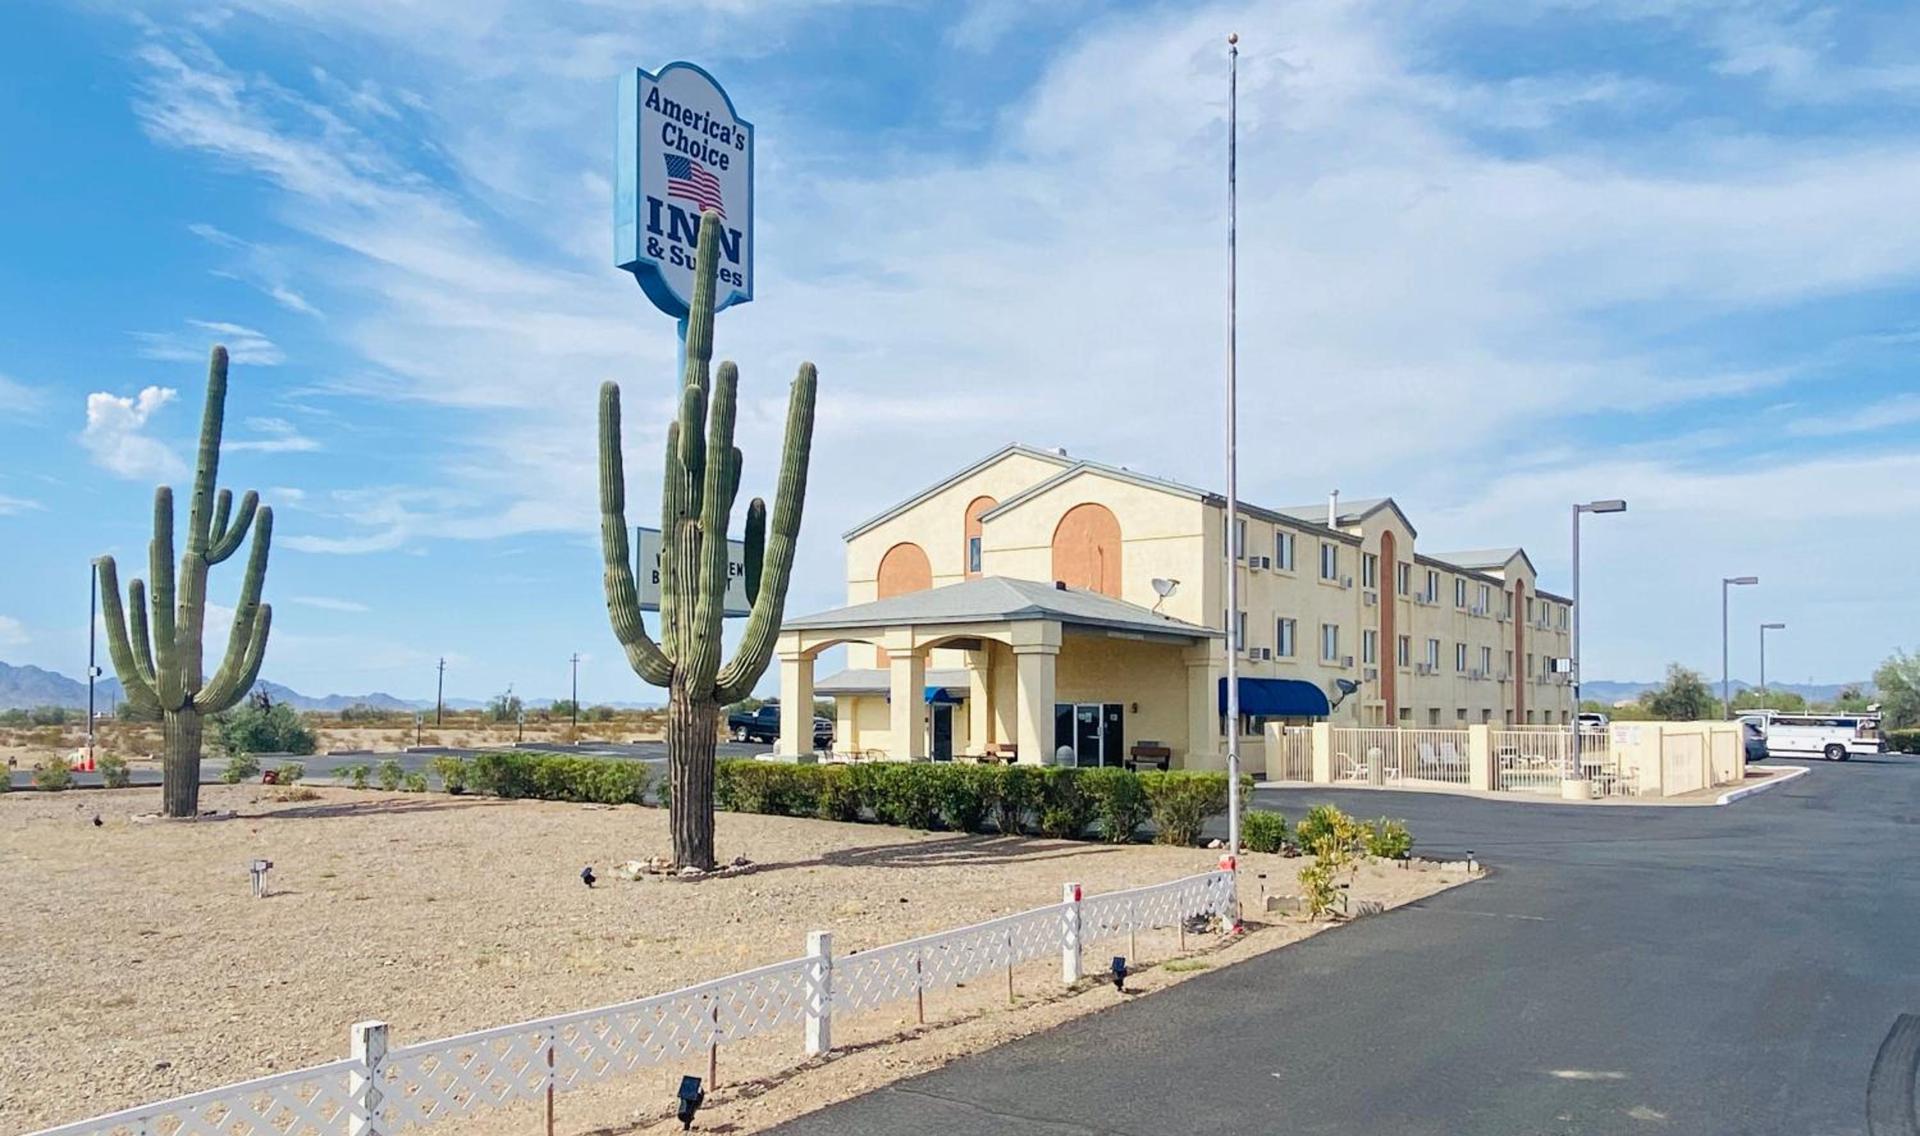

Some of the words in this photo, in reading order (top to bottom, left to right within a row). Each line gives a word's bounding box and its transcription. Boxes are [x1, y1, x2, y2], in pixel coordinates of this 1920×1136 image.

[645, 87, 746, 151] America's
[662, 122, 729, 170] Choice
[646, 195, 742, 265] INN
[646, 236, 664, 260] &
[669, 245, 743, 287] Sues
